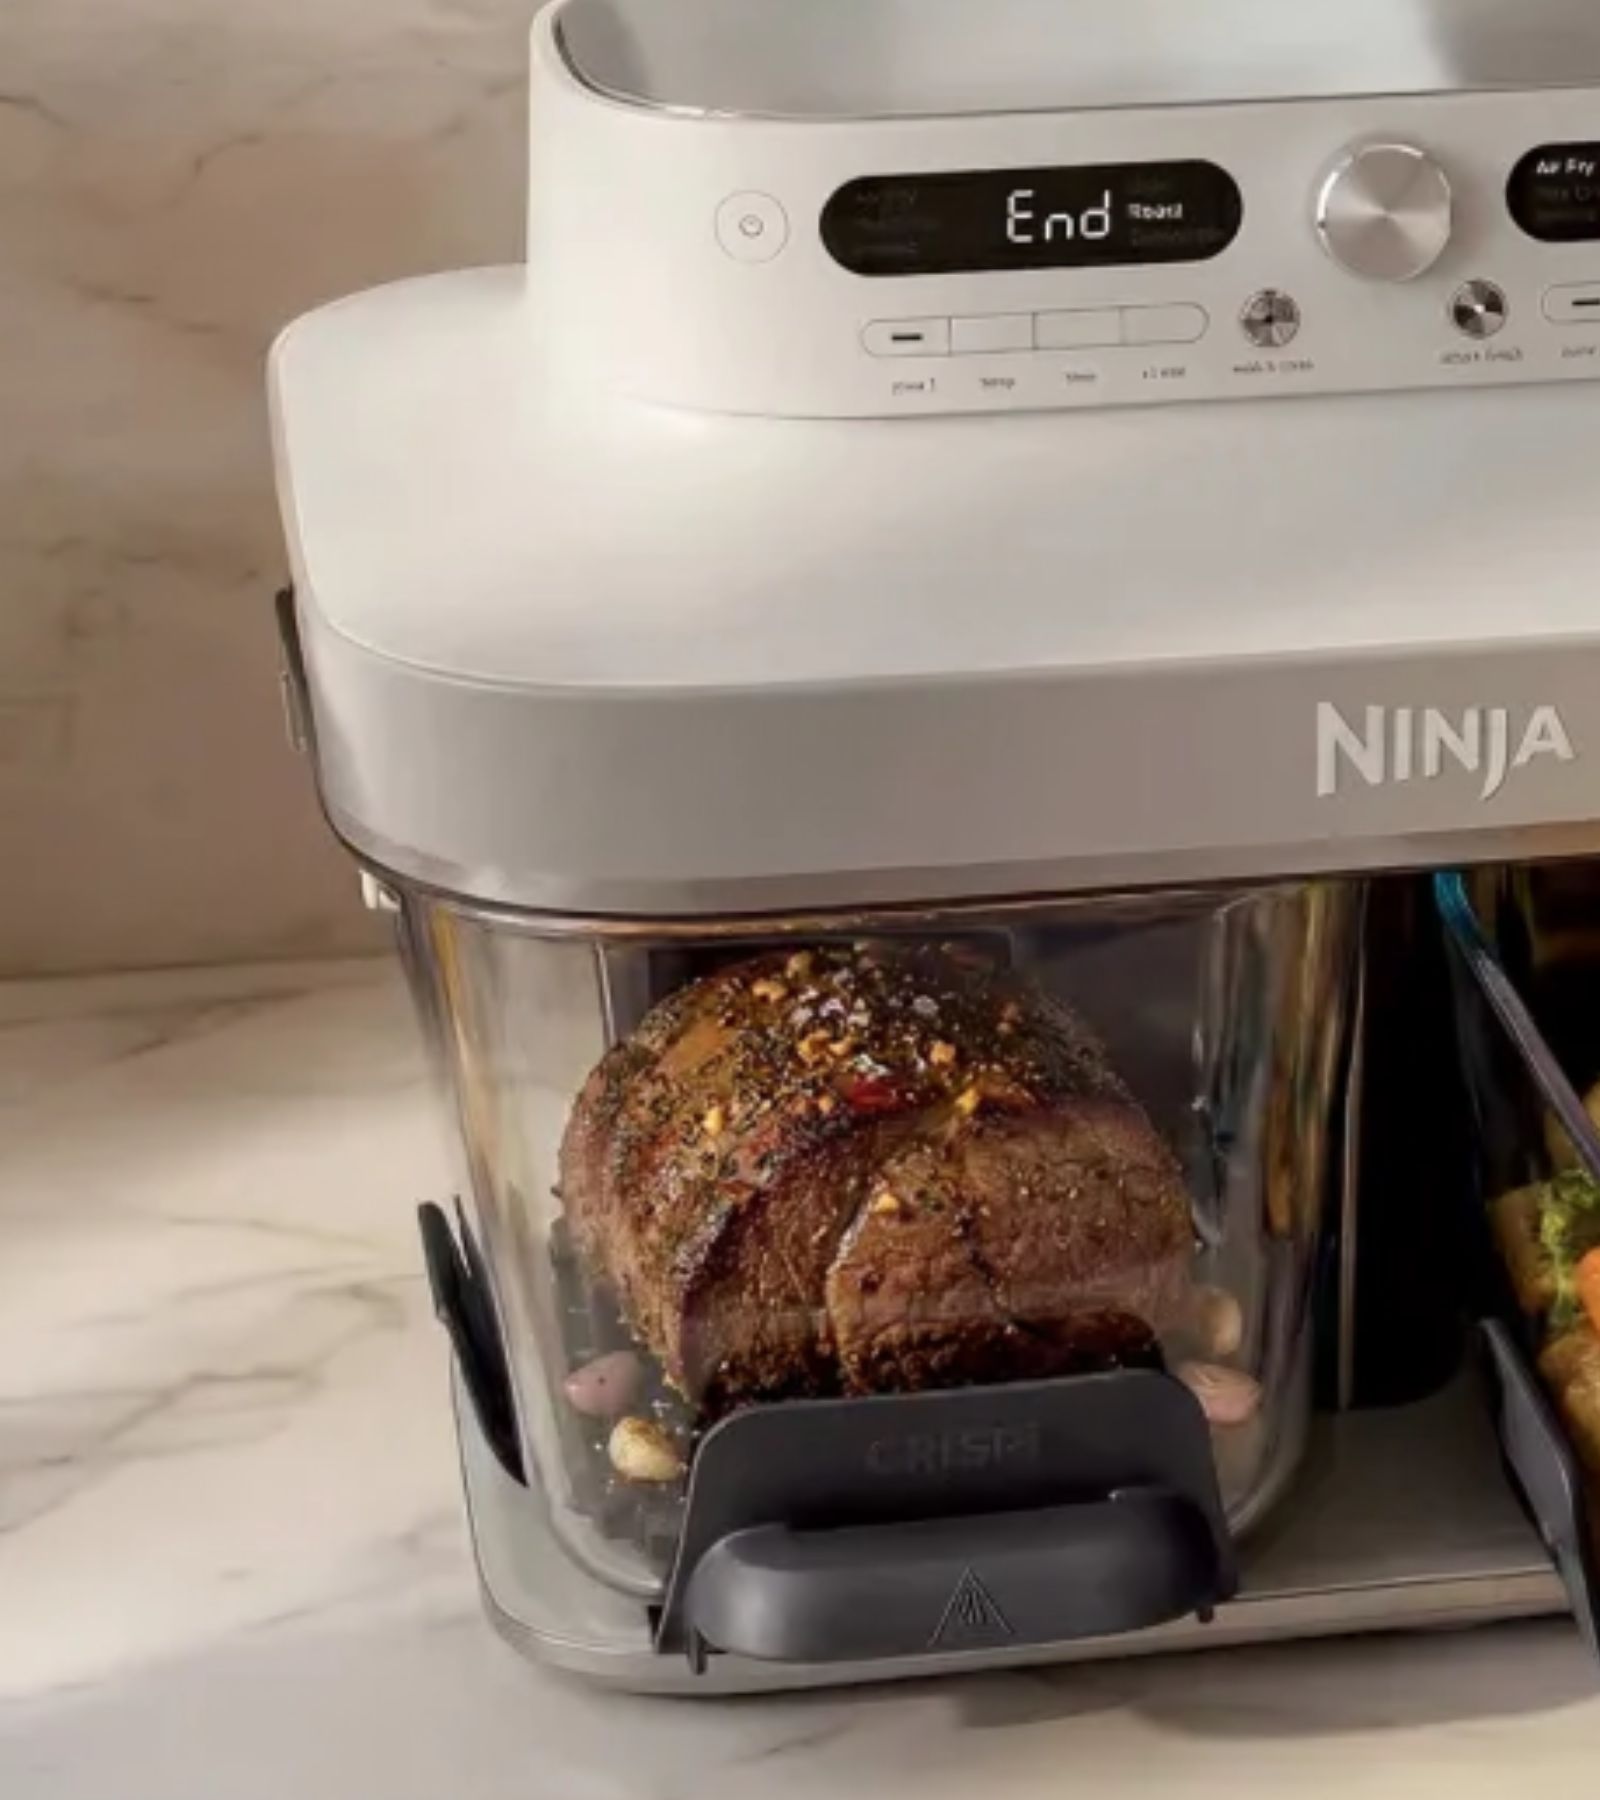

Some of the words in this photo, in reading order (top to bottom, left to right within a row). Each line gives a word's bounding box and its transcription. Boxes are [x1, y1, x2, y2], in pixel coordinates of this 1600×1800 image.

[1565, 157, 1597, 177] Fry
[1006, 189, 1111, 243] End
[1316, 701, 1576, 801] NINJA
